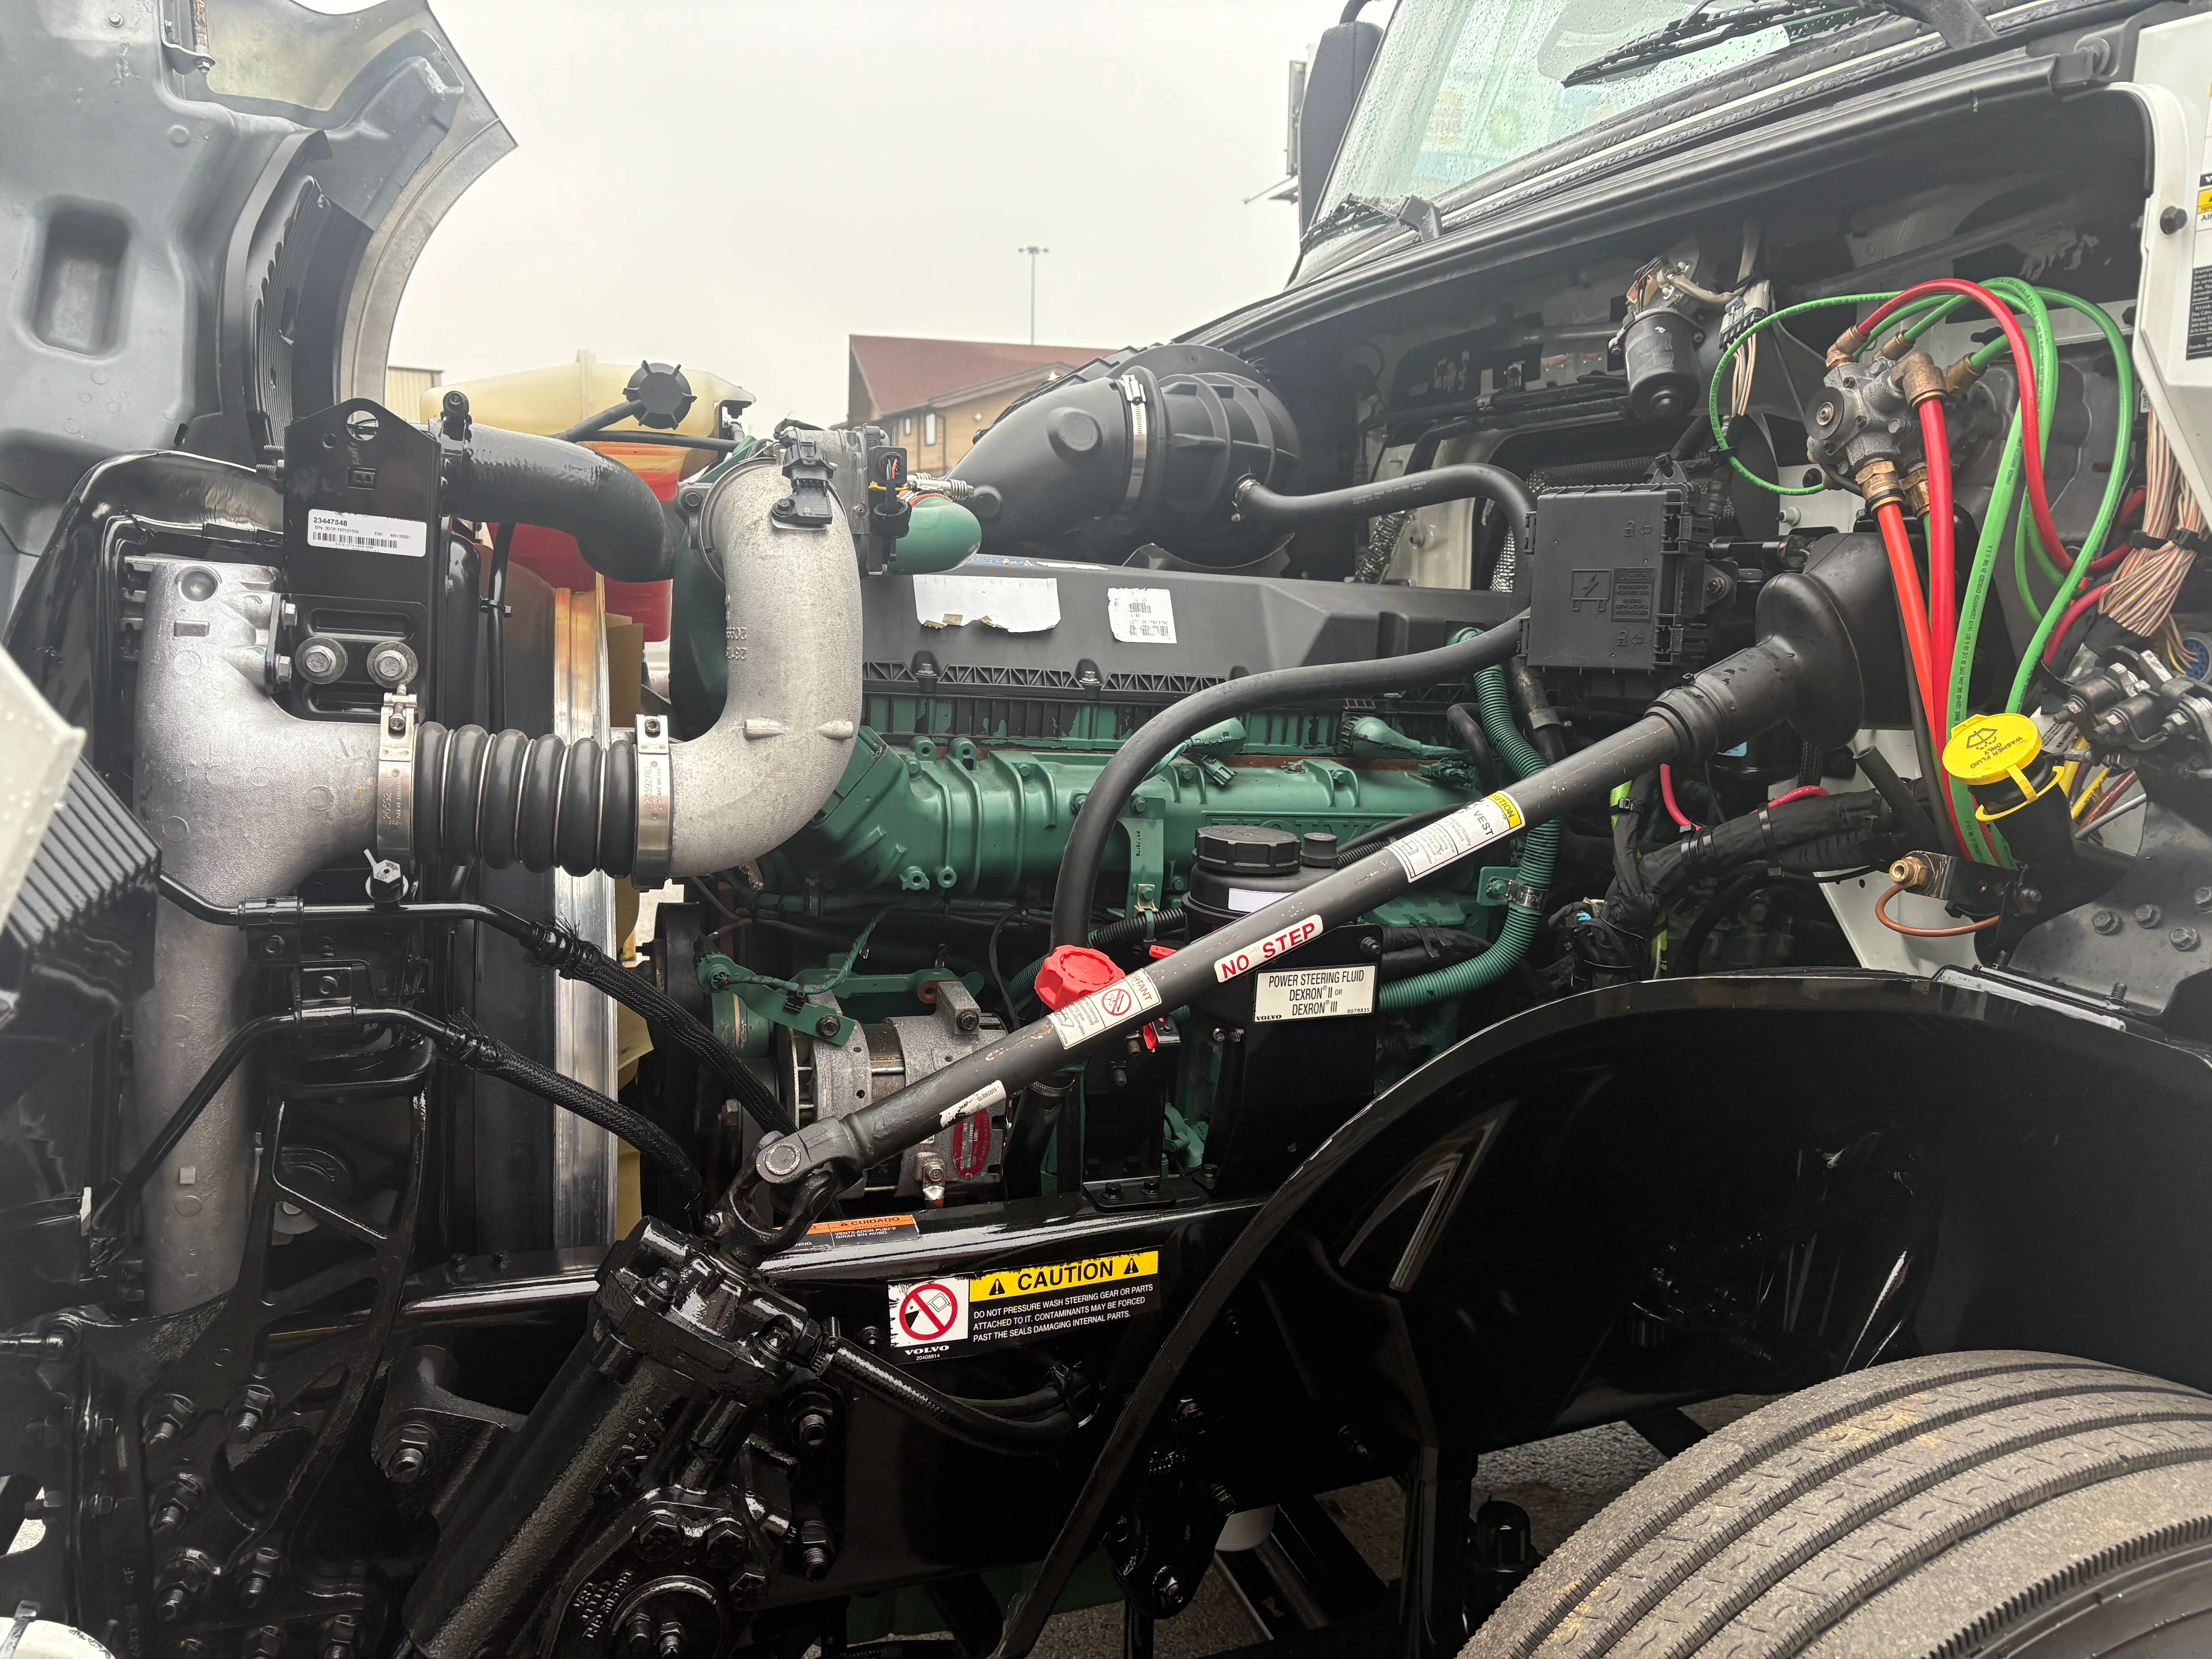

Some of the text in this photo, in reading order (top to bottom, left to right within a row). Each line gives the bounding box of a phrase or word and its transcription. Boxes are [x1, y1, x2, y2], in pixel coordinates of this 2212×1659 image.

[2006, 469, 2014, 484] PARKER
[313, 517, 347, 526] 23447548
[1970, 736, 2023, 769] WASHER FLUID
[1984, 743, 2002, 755] ONLY
[1490, 794, 1515, 817] AUTION
[1474, 810, 1493, 835] VEST
[1221, 922, 1315, 979] NO STEP
[1130, 972, 1152, 1001] ORTANT
[1269, 970, 1364, 988] POWER STEERING FLUID
[1328, 986, 1333, 998] II
[1077, 1012, 1086, 1023] gear.
[1087, 1006, 1099, 1023] steering
[851, 1217, 900, 1225] CUIDADO
[1018, 1260, 1113, 1291] CAUTION
[974, 1283, 1153, 1319] DO NOT PRESSURE WASH STEERING GEAR OR PARTS
[973, 1319, 1011, 1331] ATTACHED
[1035, 1306, 1089, 1321] CONTAMINANTS
[1091, 1303, 1106, 1313] MAY
[1107, 1302, 1116, 1310] BE
[1118, 1296, 1145, 1309] FORCED
[973, 1310, 1130, 1342] PAST THE SEALS DAMAGING INTERNAL PARTS.
[905, 1345, 950, 1356] VOLVO
